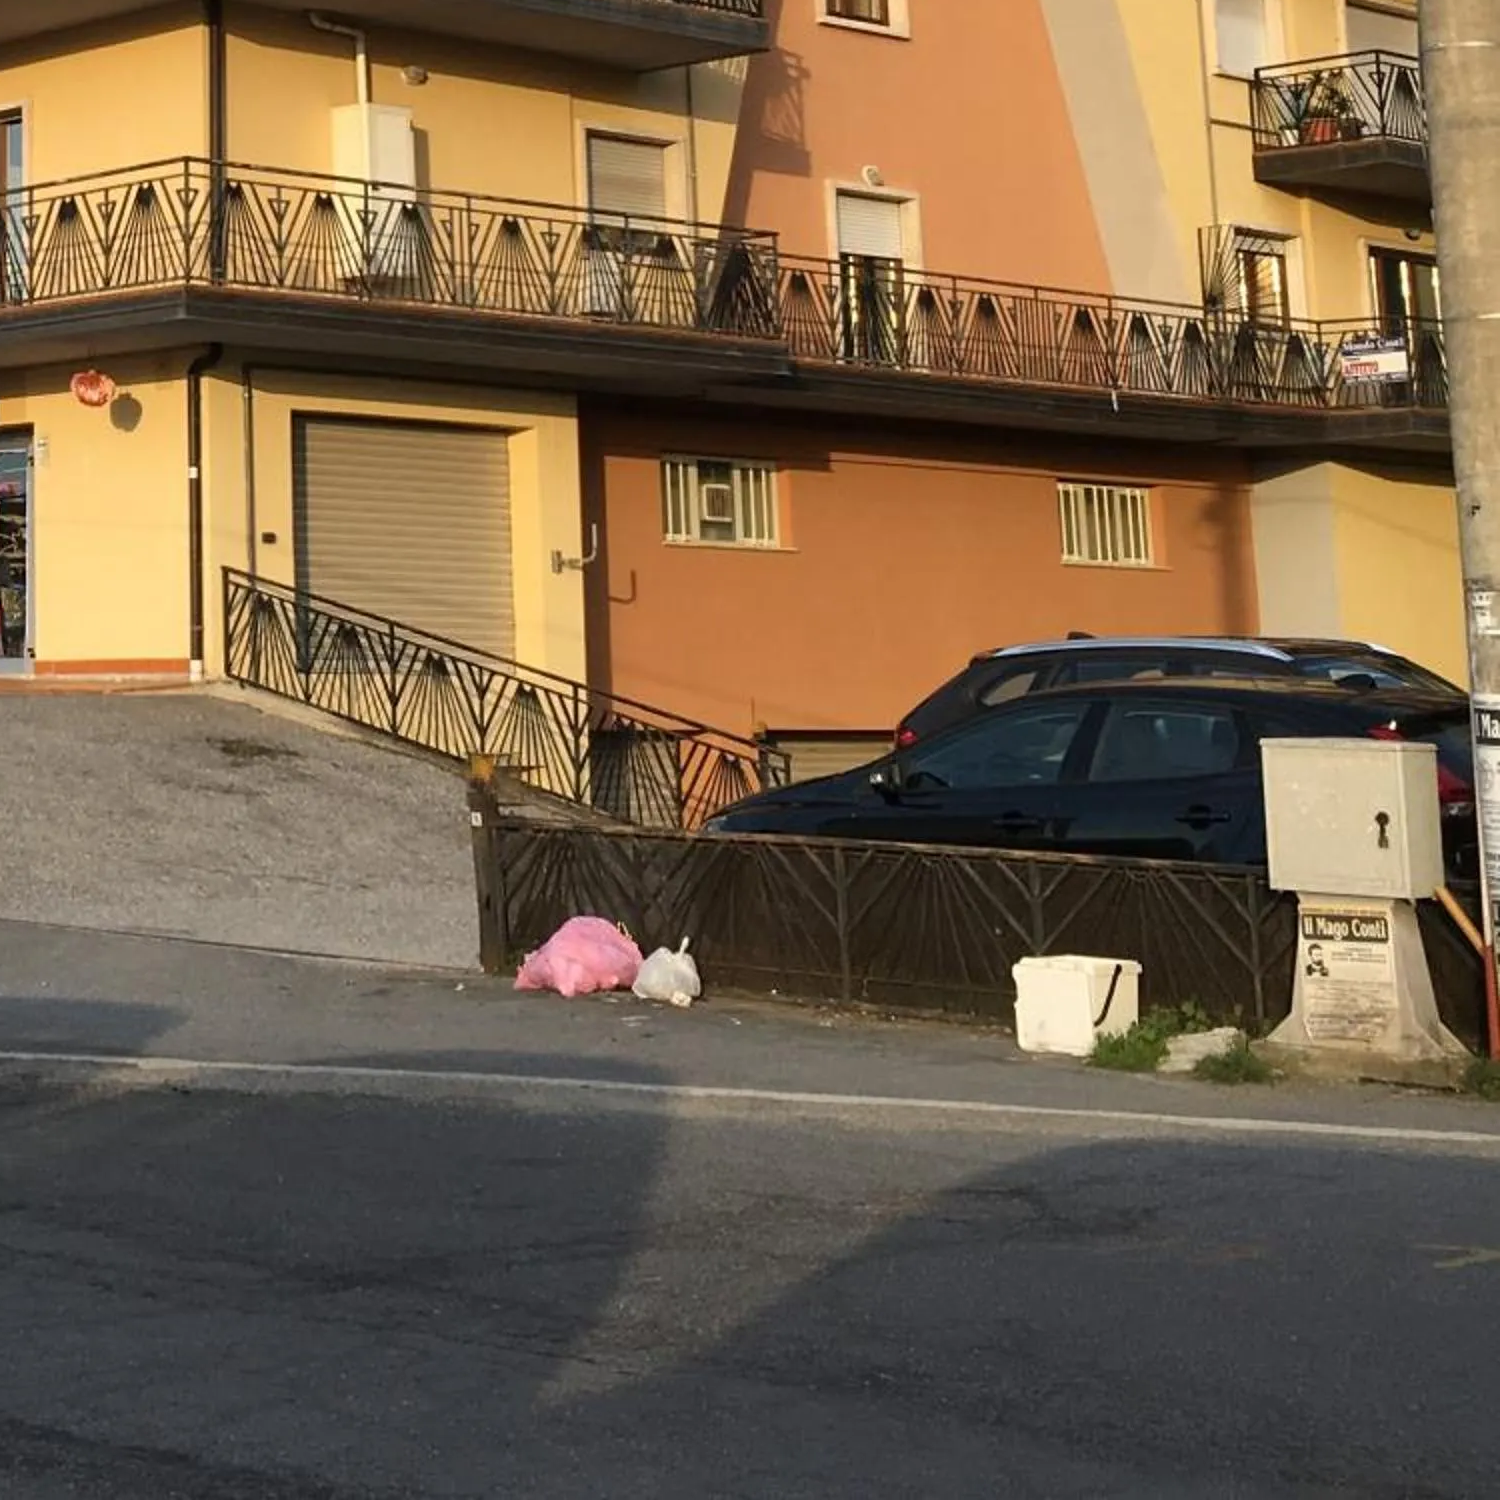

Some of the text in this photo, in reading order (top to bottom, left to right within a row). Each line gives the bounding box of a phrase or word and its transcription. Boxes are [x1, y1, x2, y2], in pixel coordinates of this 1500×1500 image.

[1304, 916, 1386, 941] Il Mago Conti
